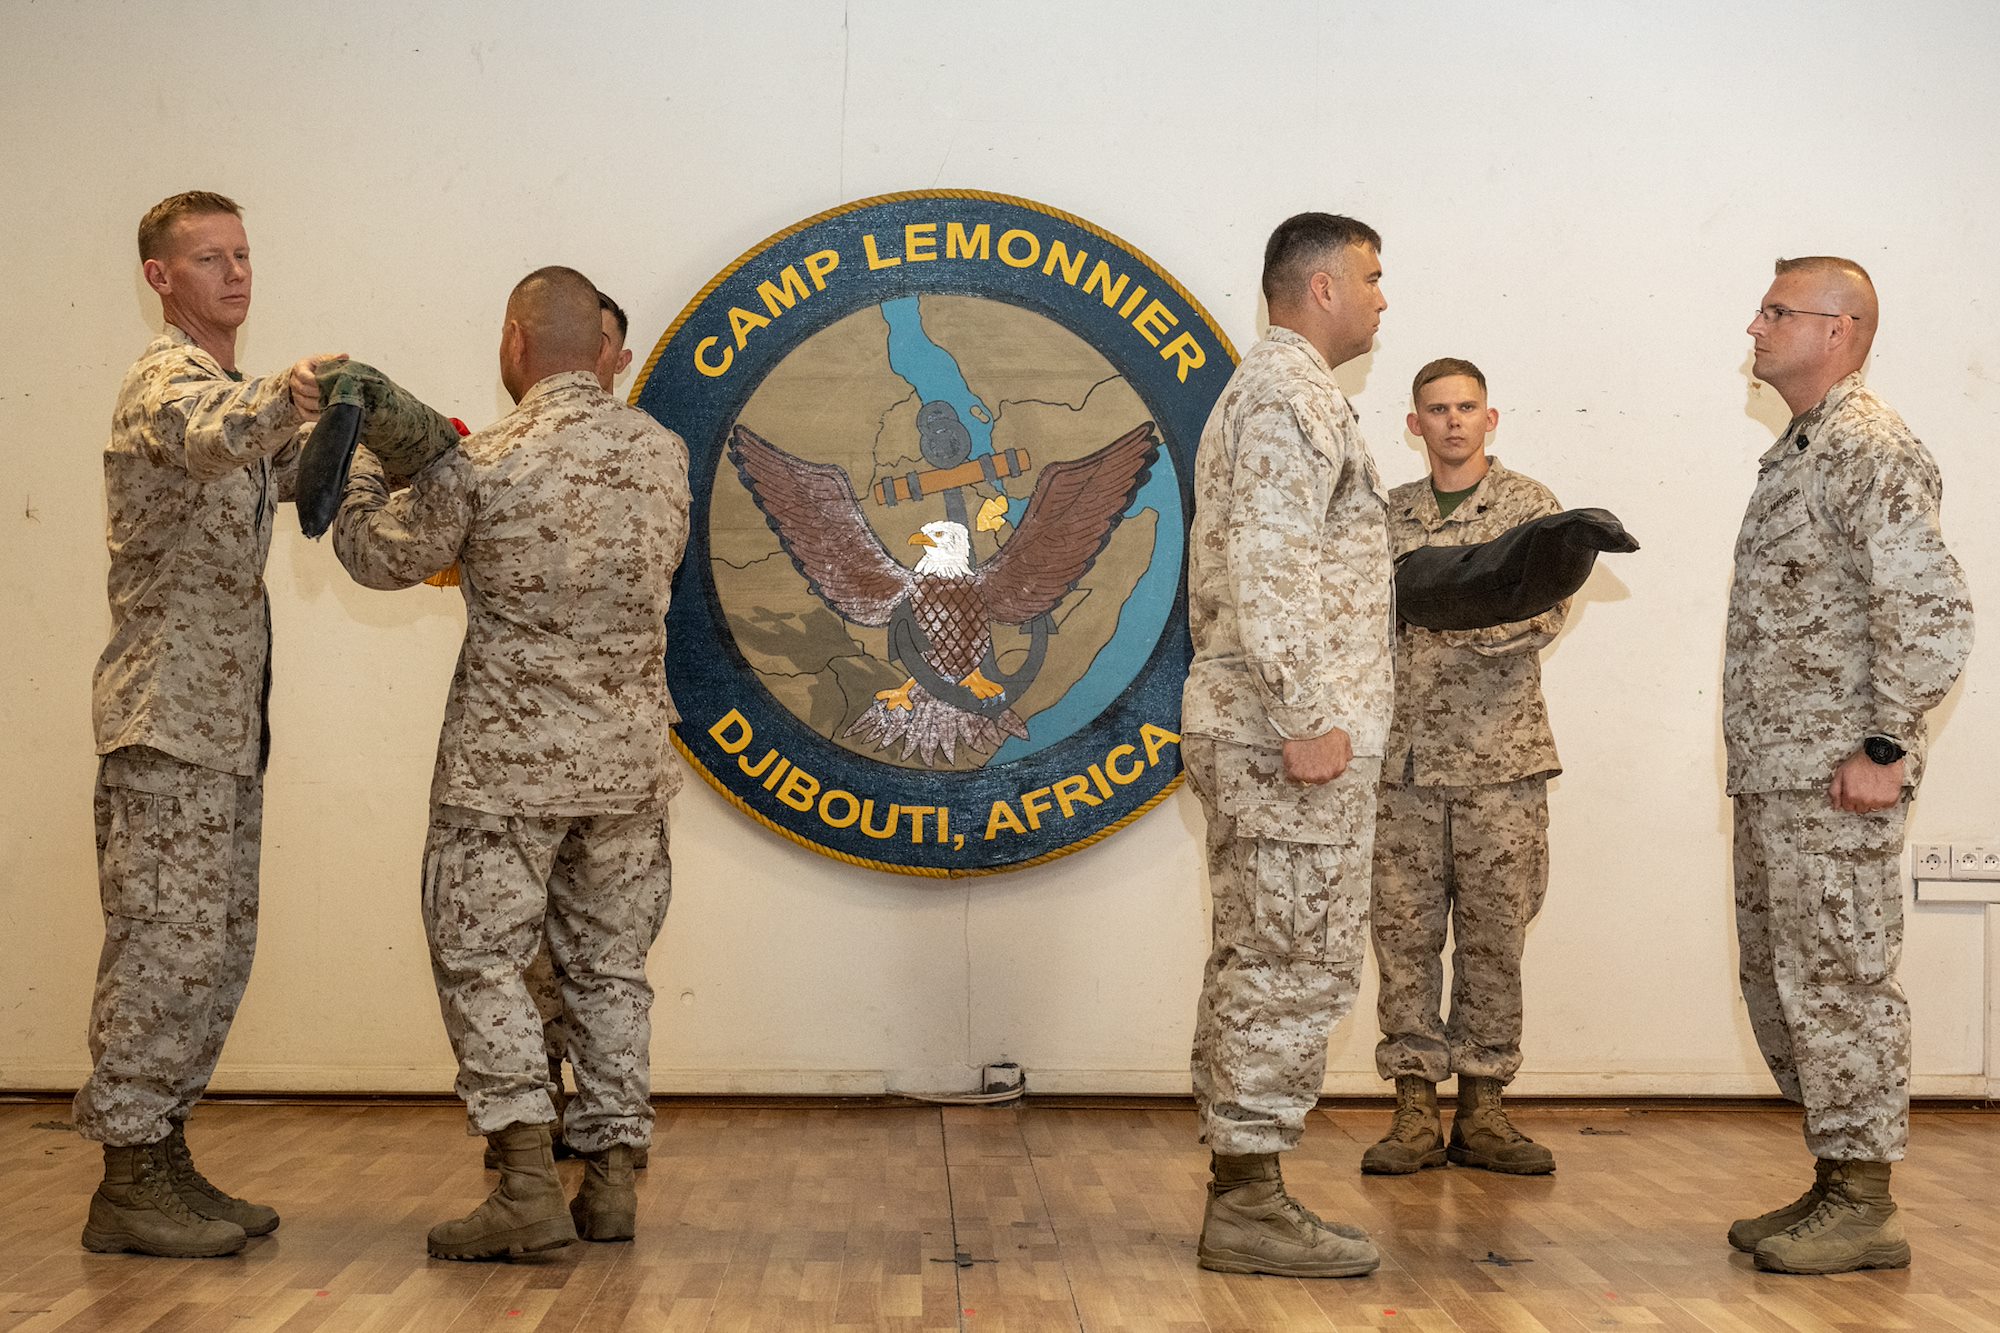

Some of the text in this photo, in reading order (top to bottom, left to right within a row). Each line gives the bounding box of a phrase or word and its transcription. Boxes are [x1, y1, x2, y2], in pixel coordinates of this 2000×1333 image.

[694, 222, 1206, 383] CAMP LEMONNIER
[708, 708, 1182, 852] DJIBOUTI, AFRICA
